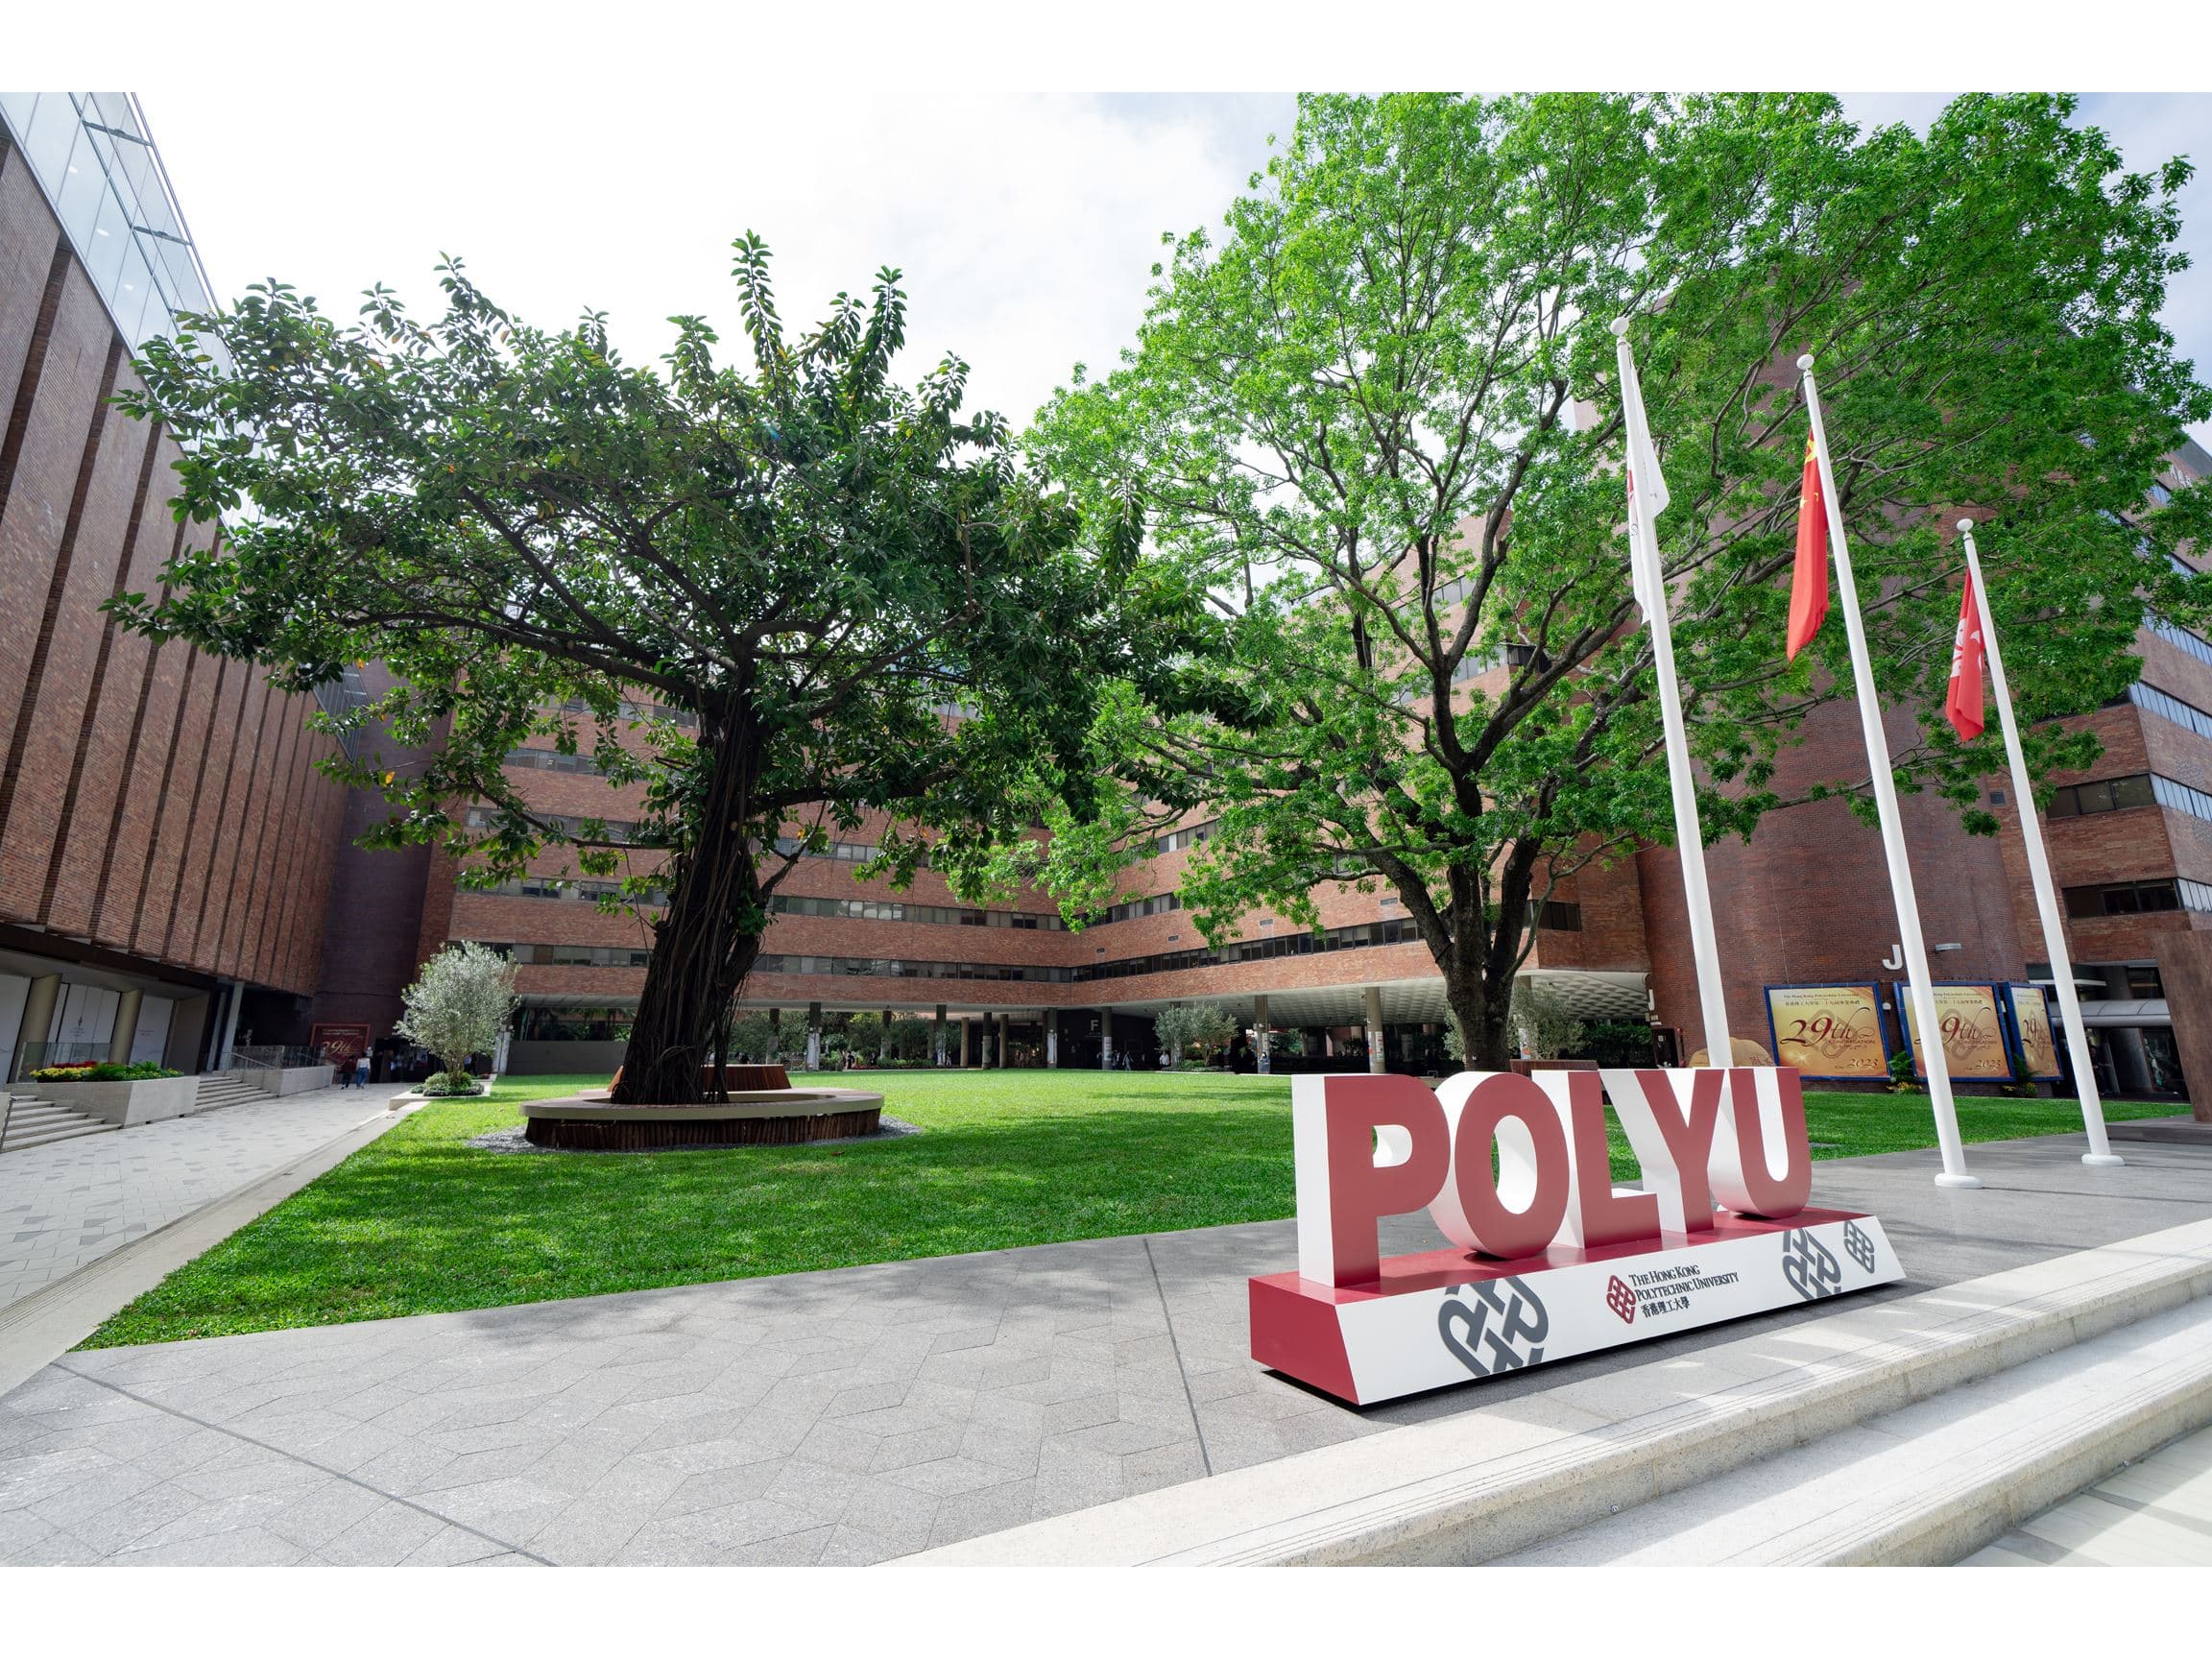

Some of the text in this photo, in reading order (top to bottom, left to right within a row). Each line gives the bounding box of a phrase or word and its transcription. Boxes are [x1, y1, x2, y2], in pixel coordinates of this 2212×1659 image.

[1883, 945, 1903, 970] J
[1091, 1020, 1098, 1031] F
[1780, 1007, 1875, 1046] 29th
[1323, 1067, 1813, 1287] POLYU
[1628, 1264, 1700, 1286] THE HONG KONG
[1635, 1272, 1740, 1302] POLYTECHNIC UNIVERSITY
[1641, 1296, 1690, 1318] 香港理工大學
